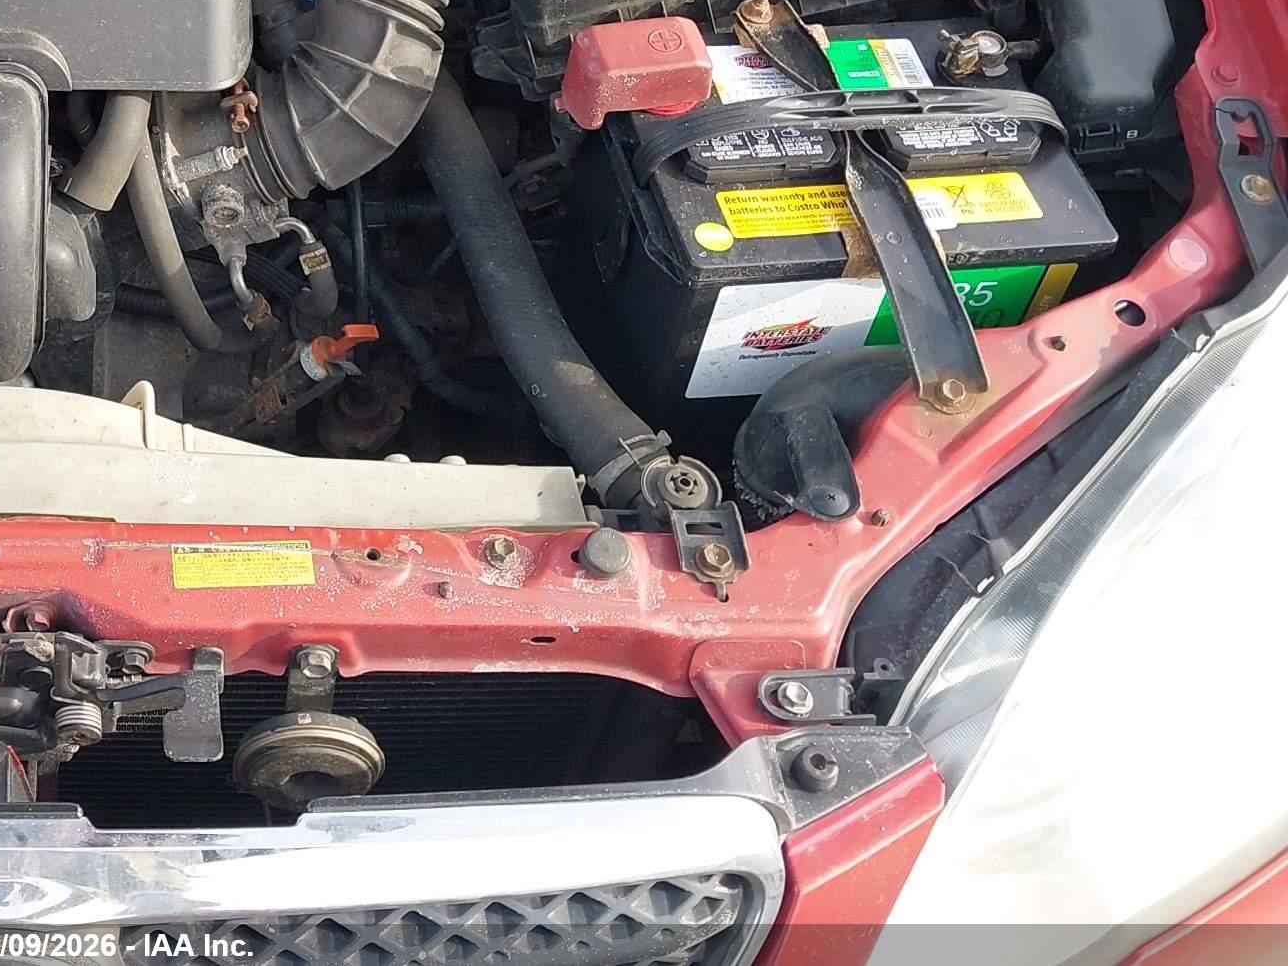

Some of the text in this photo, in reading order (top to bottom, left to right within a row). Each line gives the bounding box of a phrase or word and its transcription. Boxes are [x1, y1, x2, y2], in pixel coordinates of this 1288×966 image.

[724, 188, 849, 205] Return warranty and use
[728, 204, 774, 217] batteries
[775, 204, 787, 214] to
[787, 201, 821, 213] Costco
[740, 334, 824, 349] BATTERIES
[742, 325, 833, 342] INTERSTATE
